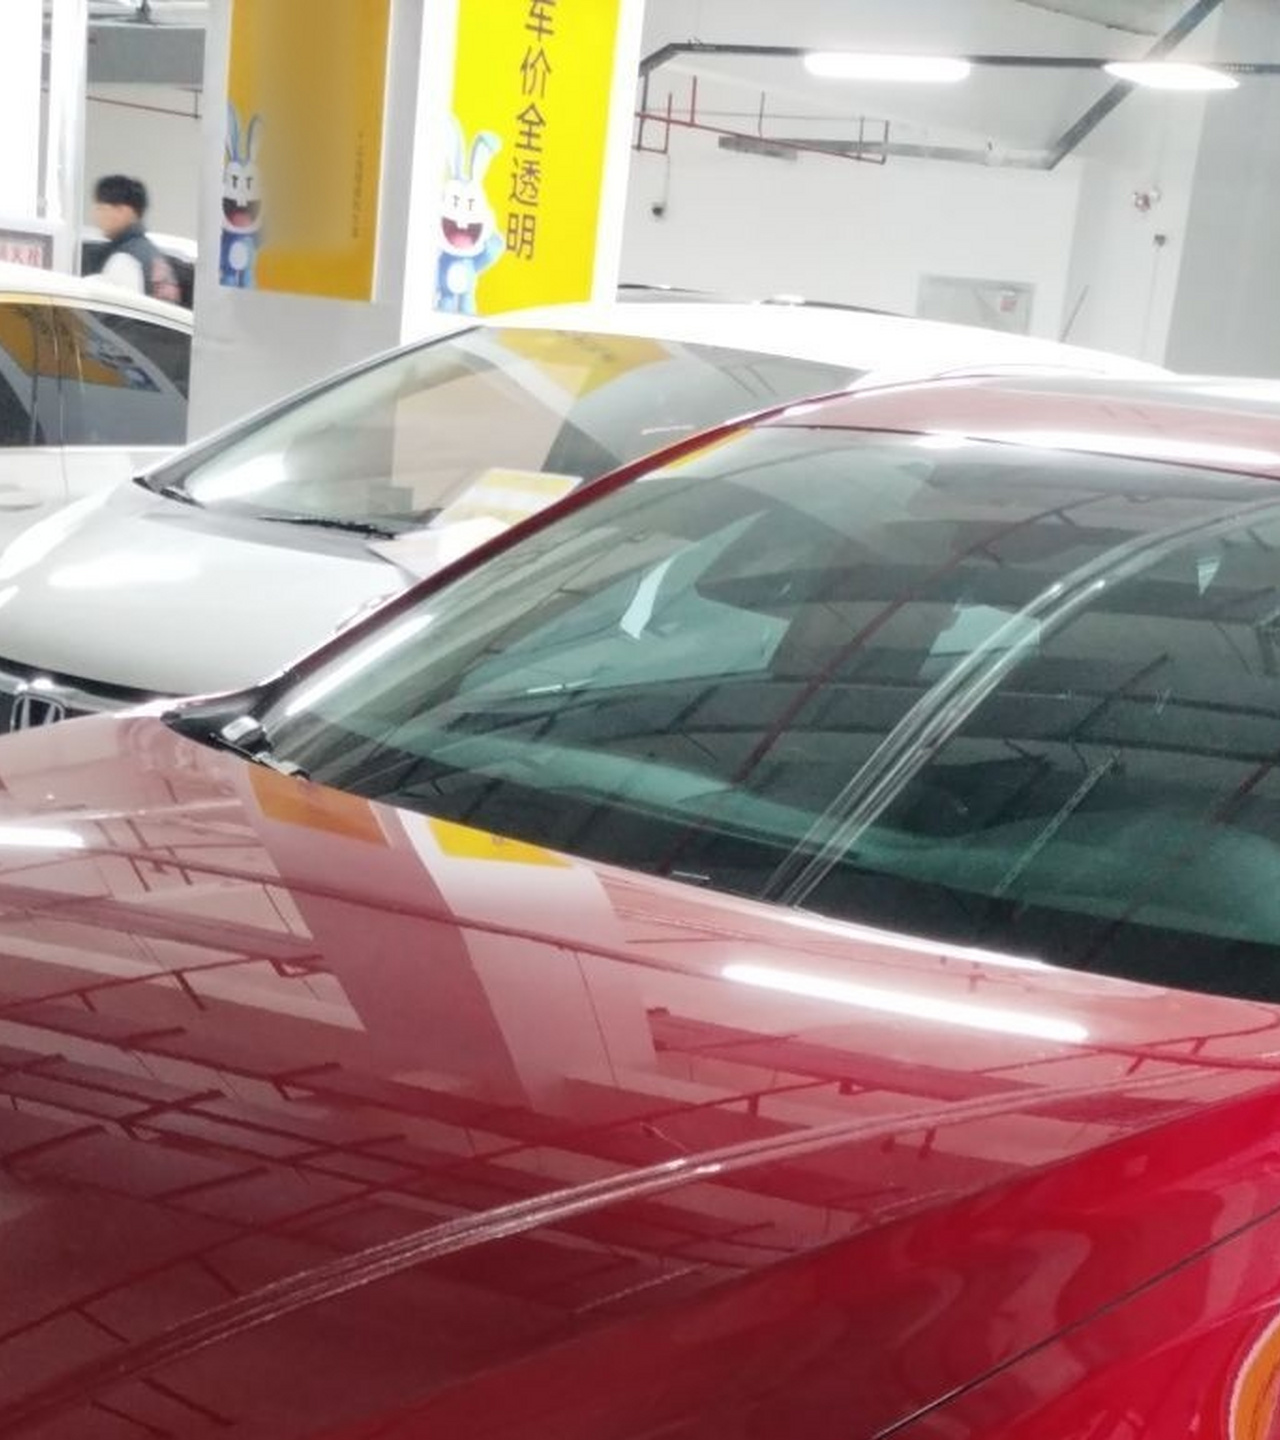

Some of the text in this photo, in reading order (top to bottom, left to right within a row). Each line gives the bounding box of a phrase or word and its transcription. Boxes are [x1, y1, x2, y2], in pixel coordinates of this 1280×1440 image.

[506, 0, 556, 260] 车价全透明
